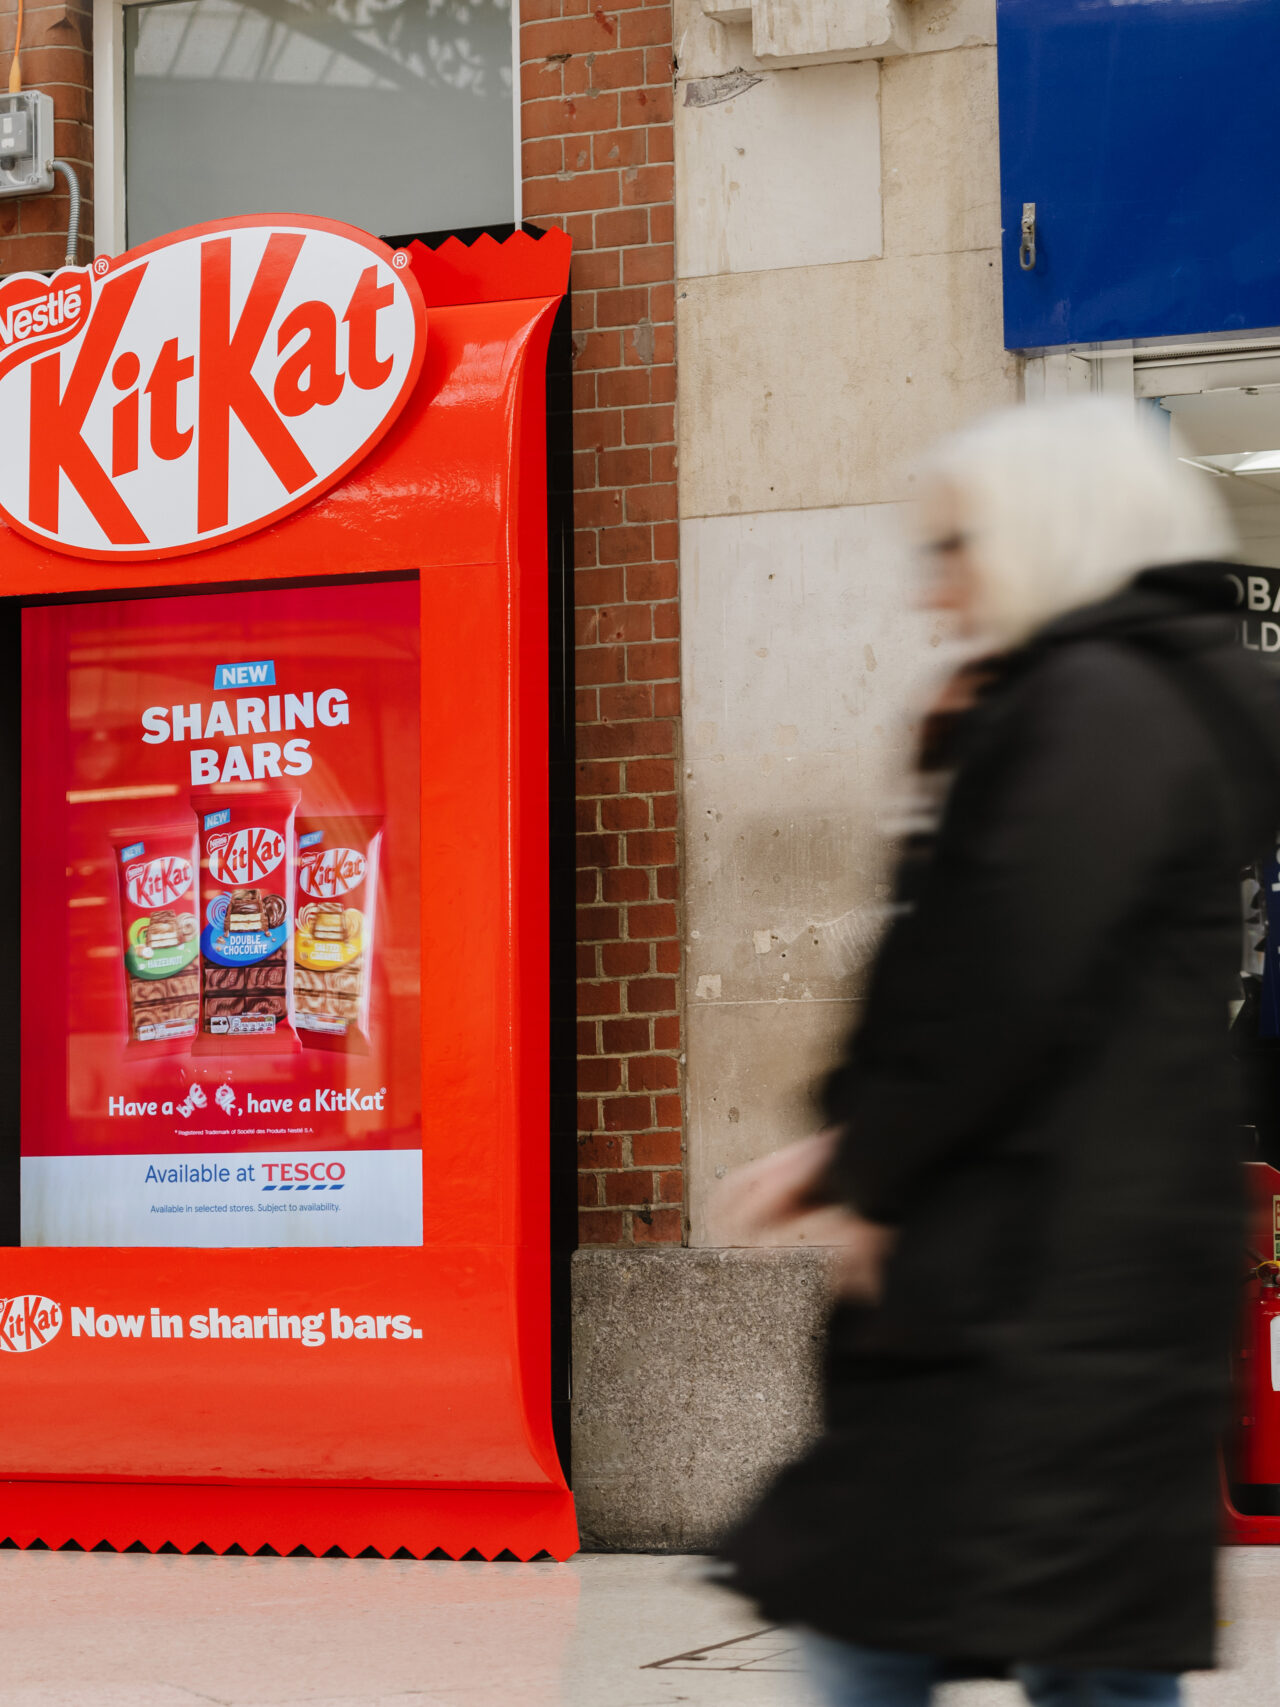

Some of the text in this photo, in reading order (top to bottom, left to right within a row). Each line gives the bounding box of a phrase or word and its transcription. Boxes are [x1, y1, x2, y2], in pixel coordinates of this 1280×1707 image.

[222, 664, 268, 686] NEW
[141, 688, 350, 744] SHARING
[190, 738, 313, 786] BARS
[207, 811, 228, 828] NEW
[223, 944, 268, 956] CHOCOLATE
[230, 934, 261, 945] DOUBLE
[108, 1096, 158, 1116] Have
[161, 1101, 174, 1115] a
[247, 1093, 293, 1113] have
[298, 1098, 311, 1112] a
[145, 1162, 346, 1184] Available at TESCO
[150, 1202, 341, 1214] Available in selected stores. Subject to availability.
[70, 1306, 423, 1347] Now in sharing bars.
